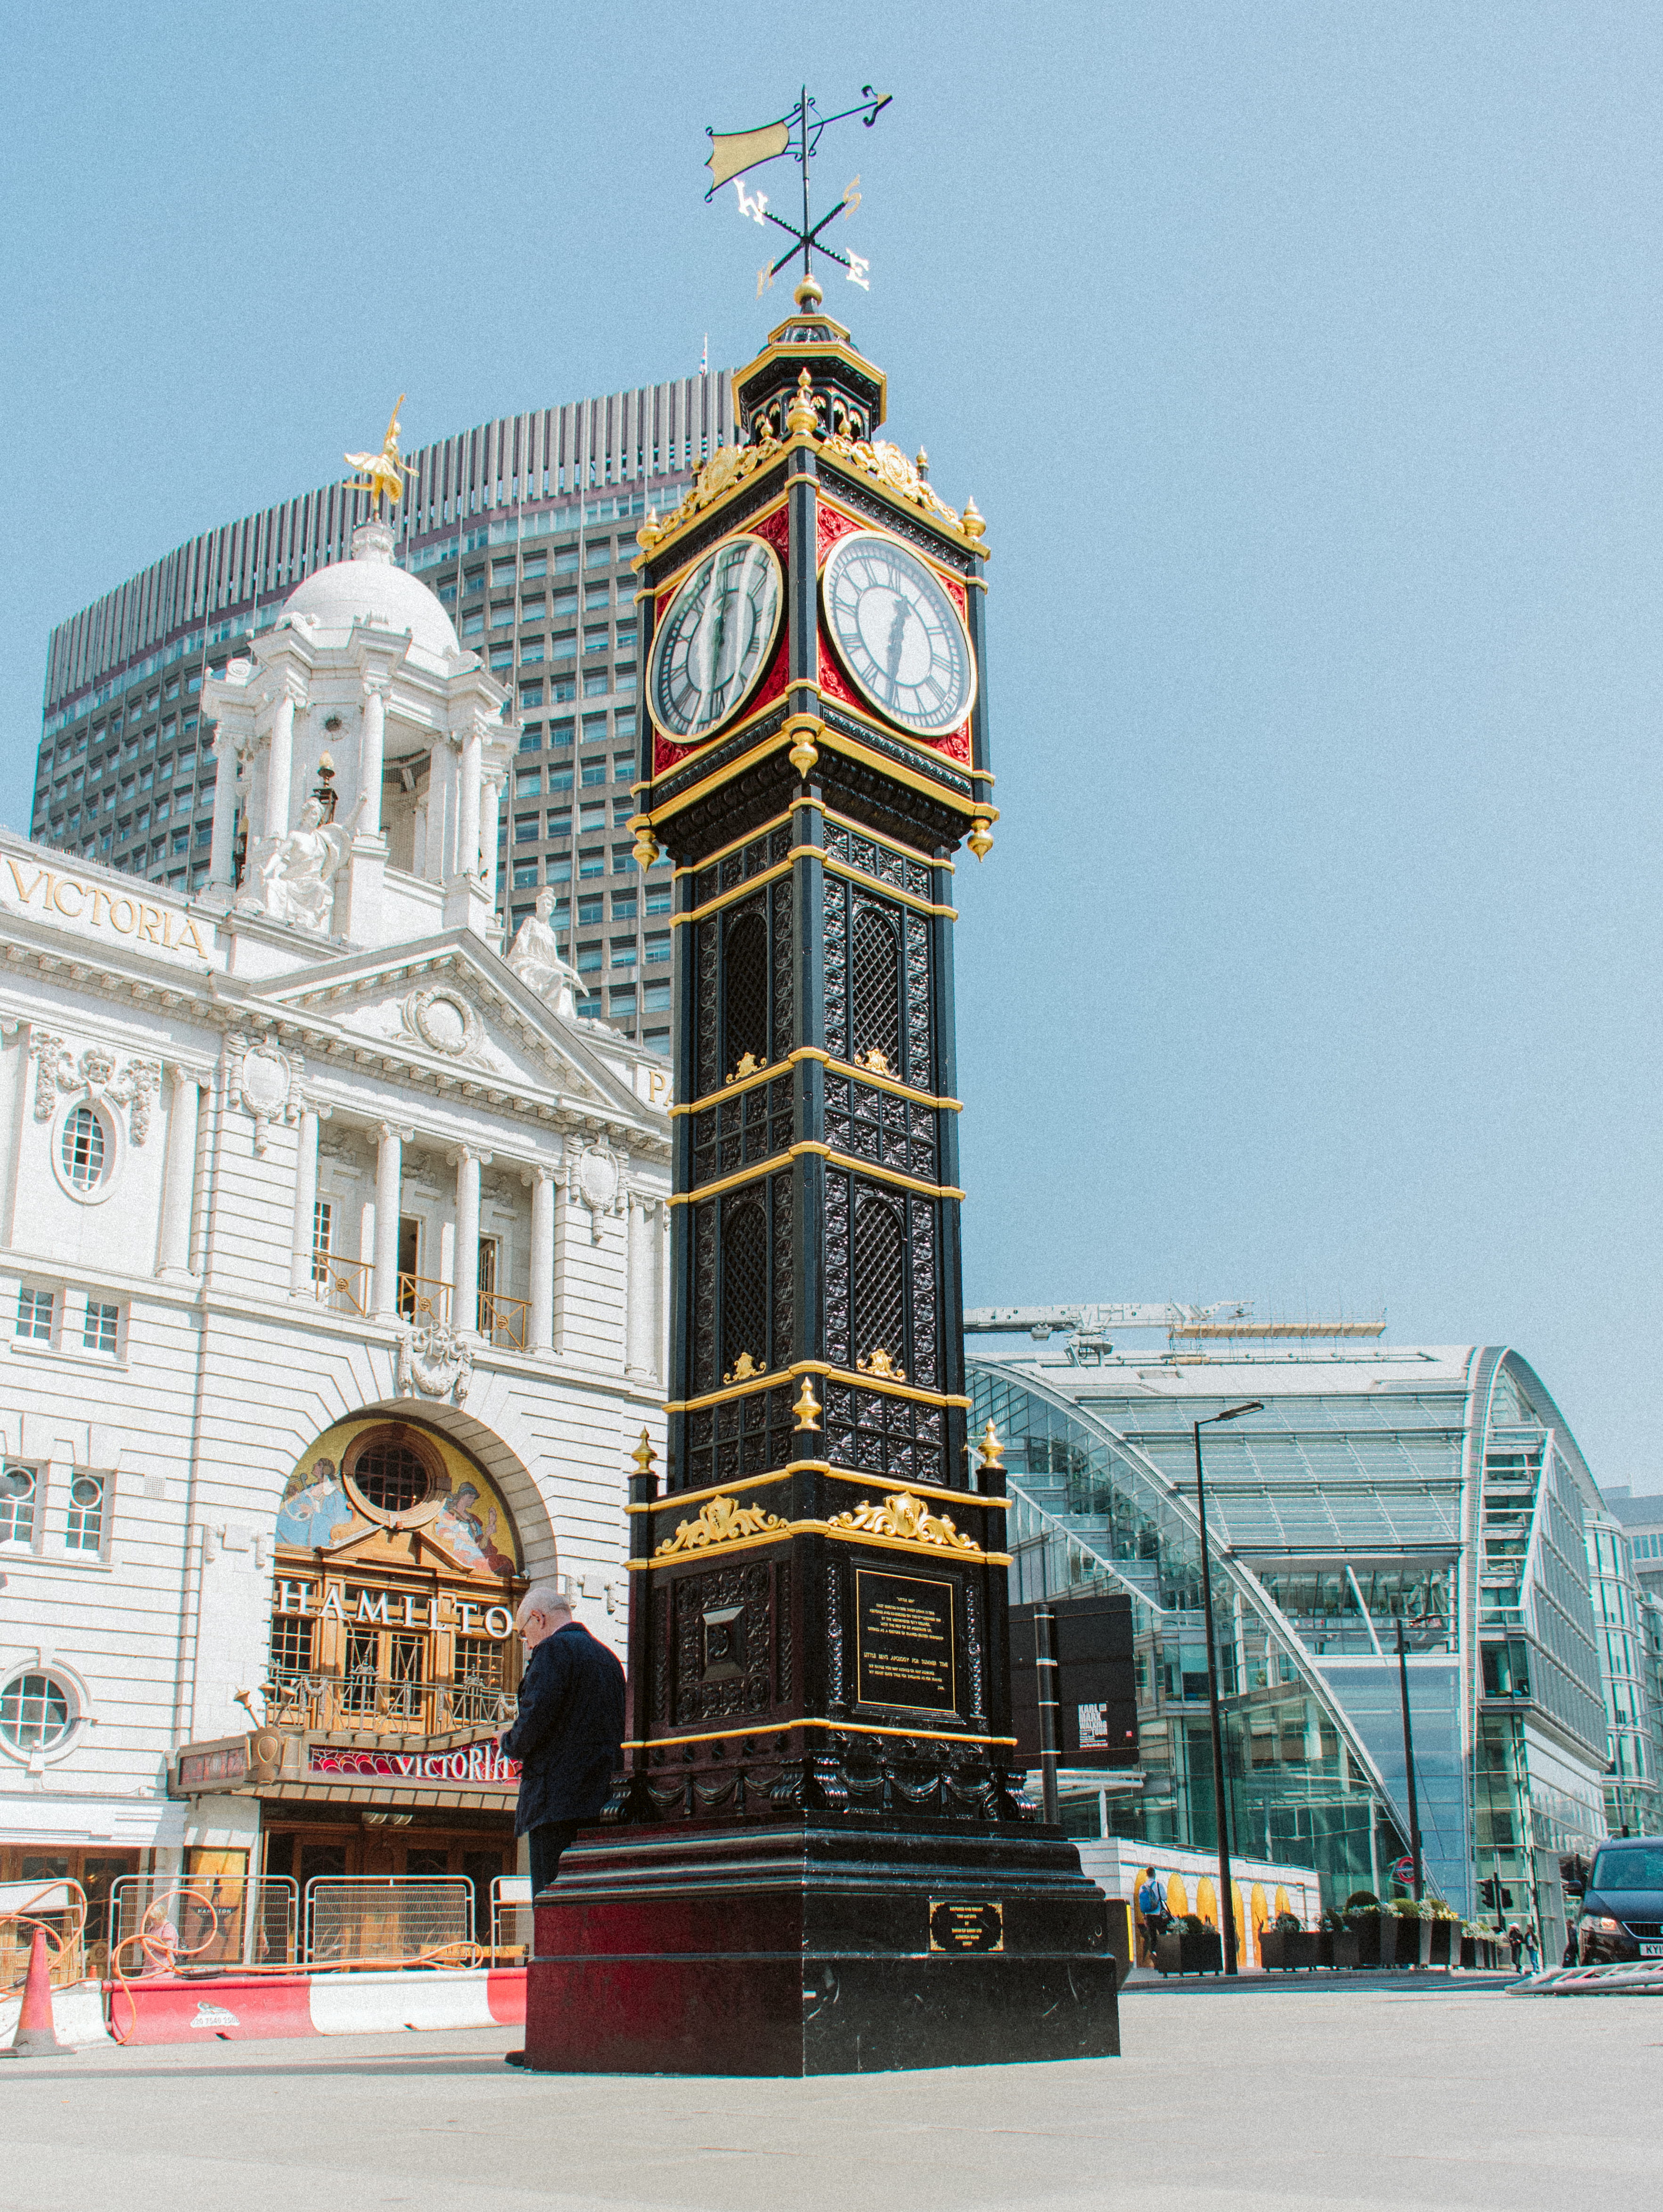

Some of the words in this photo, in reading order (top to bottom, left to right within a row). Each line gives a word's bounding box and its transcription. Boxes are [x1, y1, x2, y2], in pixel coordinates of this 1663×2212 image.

[846, 248, 870, 291] E
[7, 860, 208, 959] VICTORIA
[277, 1579, 514, 1639] HAMILTO
[891, 1655, 909, 1663] APOLOGY
[1078, 1703, 1098, 1714] KARL
[1079, 1720, 1107, 1730] WALKING
[1091, 1728, 1108, 1736] TOUR
[394, 1744, 509, 1781] VICTORIA
[1646, 1944, 1663, 1954] KY1
